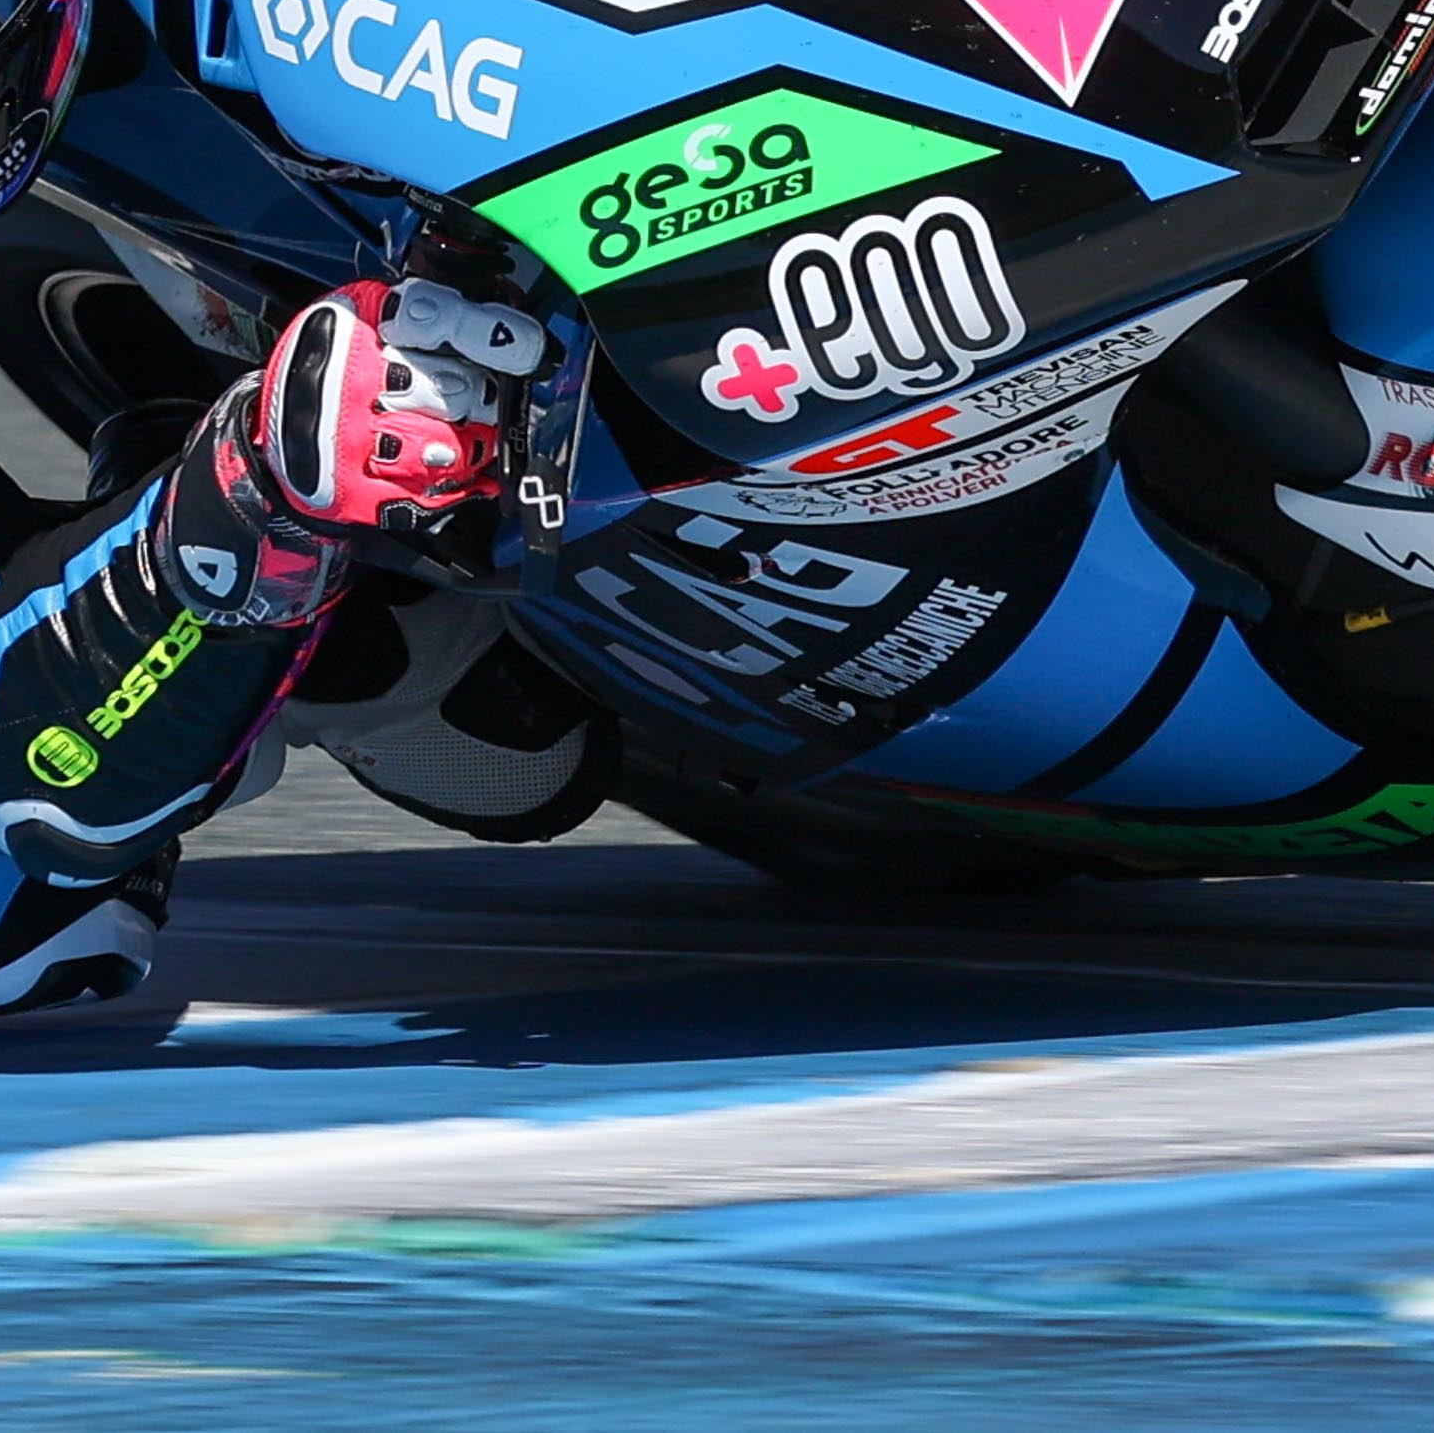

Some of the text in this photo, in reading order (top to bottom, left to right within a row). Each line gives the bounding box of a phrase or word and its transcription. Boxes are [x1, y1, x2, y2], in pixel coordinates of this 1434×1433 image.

[656, 172, 806, 241] SPORTS
[961, 325, 1154, 402] TREVISAN
[975, 333, 1165, 413] MACCHINE
[991, 355, 1143, 419] UTENSILI
[789, 405, 962, 474] GT
[890, 475, 1007, 512] POLVERI
